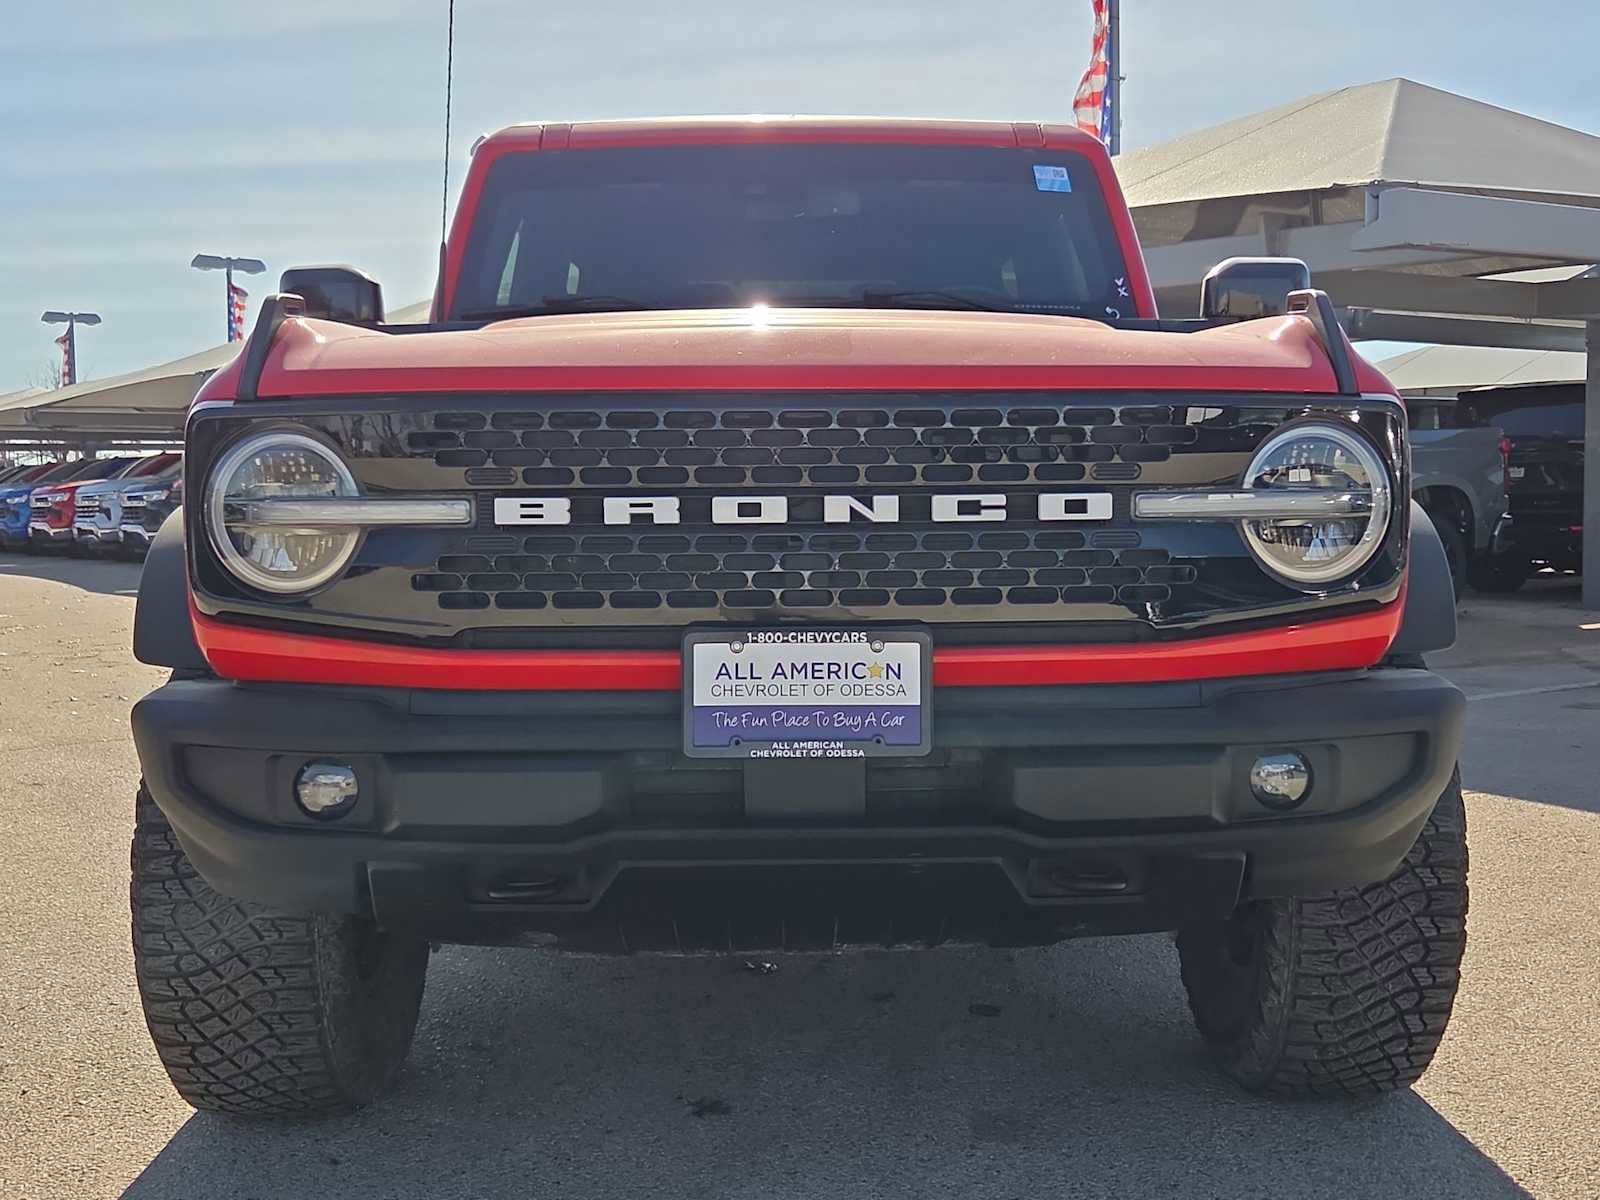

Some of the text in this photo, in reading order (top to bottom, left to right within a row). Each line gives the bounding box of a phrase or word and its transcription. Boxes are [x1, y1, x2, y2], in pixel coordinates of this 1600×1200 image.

[494, 491, 1113, 526] BRONCO
[747, 632, 868, 643] 1-800-CHEVYCARS
[715, 662, 762, 680] ALL
[711, 684, 907, 697] CHEVROLET OF ODESSA
[712, 711, 905, 732] The Fun Place To Buy A Car
[772, 741, 843, 749] ALL AMERICAN
[751, 750, 865, 758] CHEVROLET OF ODESSA
